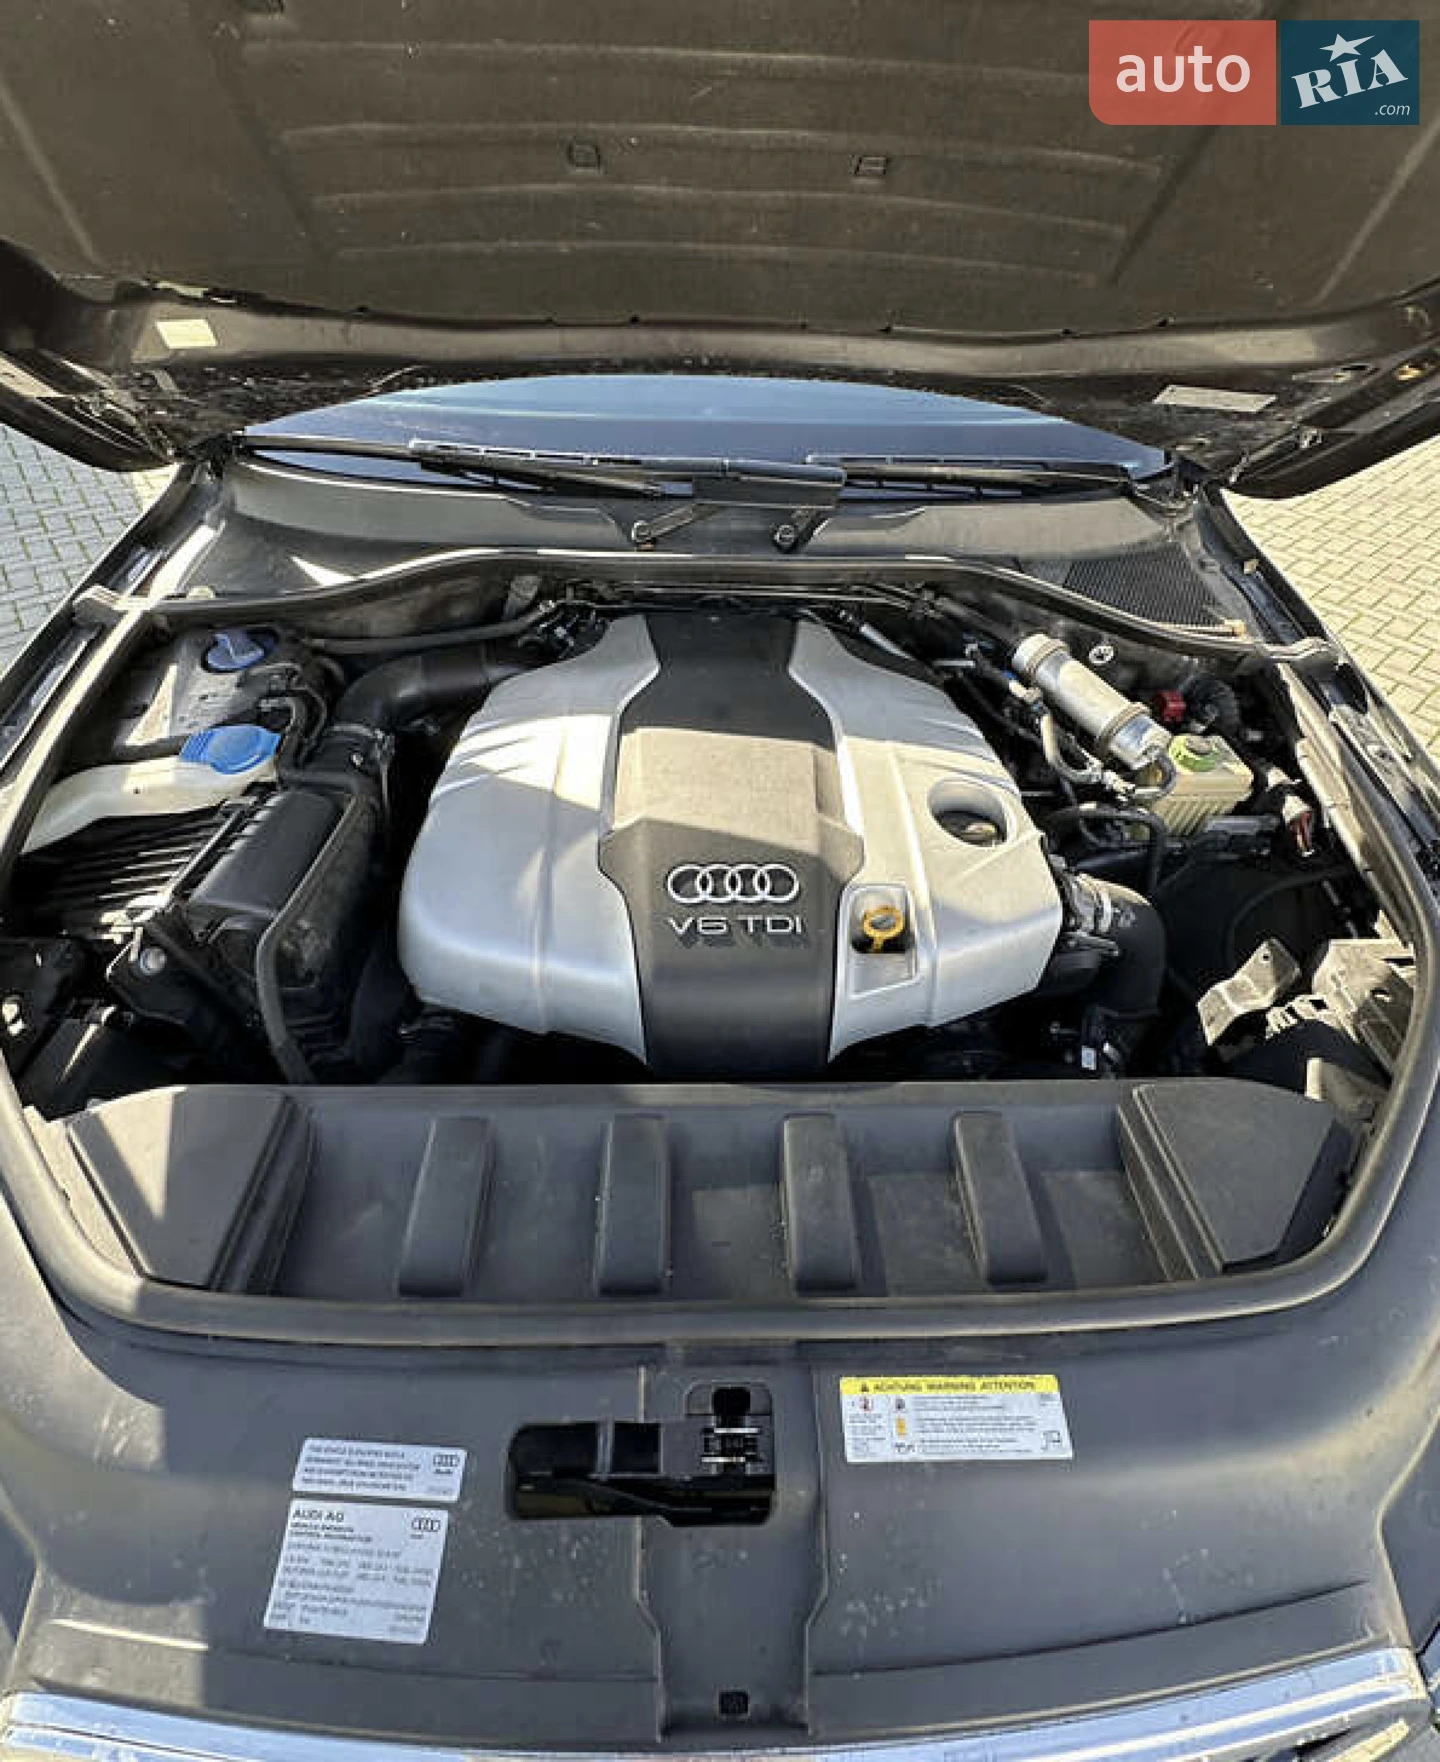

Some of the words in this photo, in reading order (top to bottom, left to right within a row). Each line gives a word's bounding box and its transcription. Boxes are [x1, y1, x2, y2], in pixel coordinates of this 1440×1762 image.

[668, 916, 728, 935] V6
[738, 915, 802, 934] TDI
[926, 1381, 976, 1391] WARNING
[979, 1380, 1036, 1390] ATTENTION
[292, 1509, 323, 1520] AUDI
